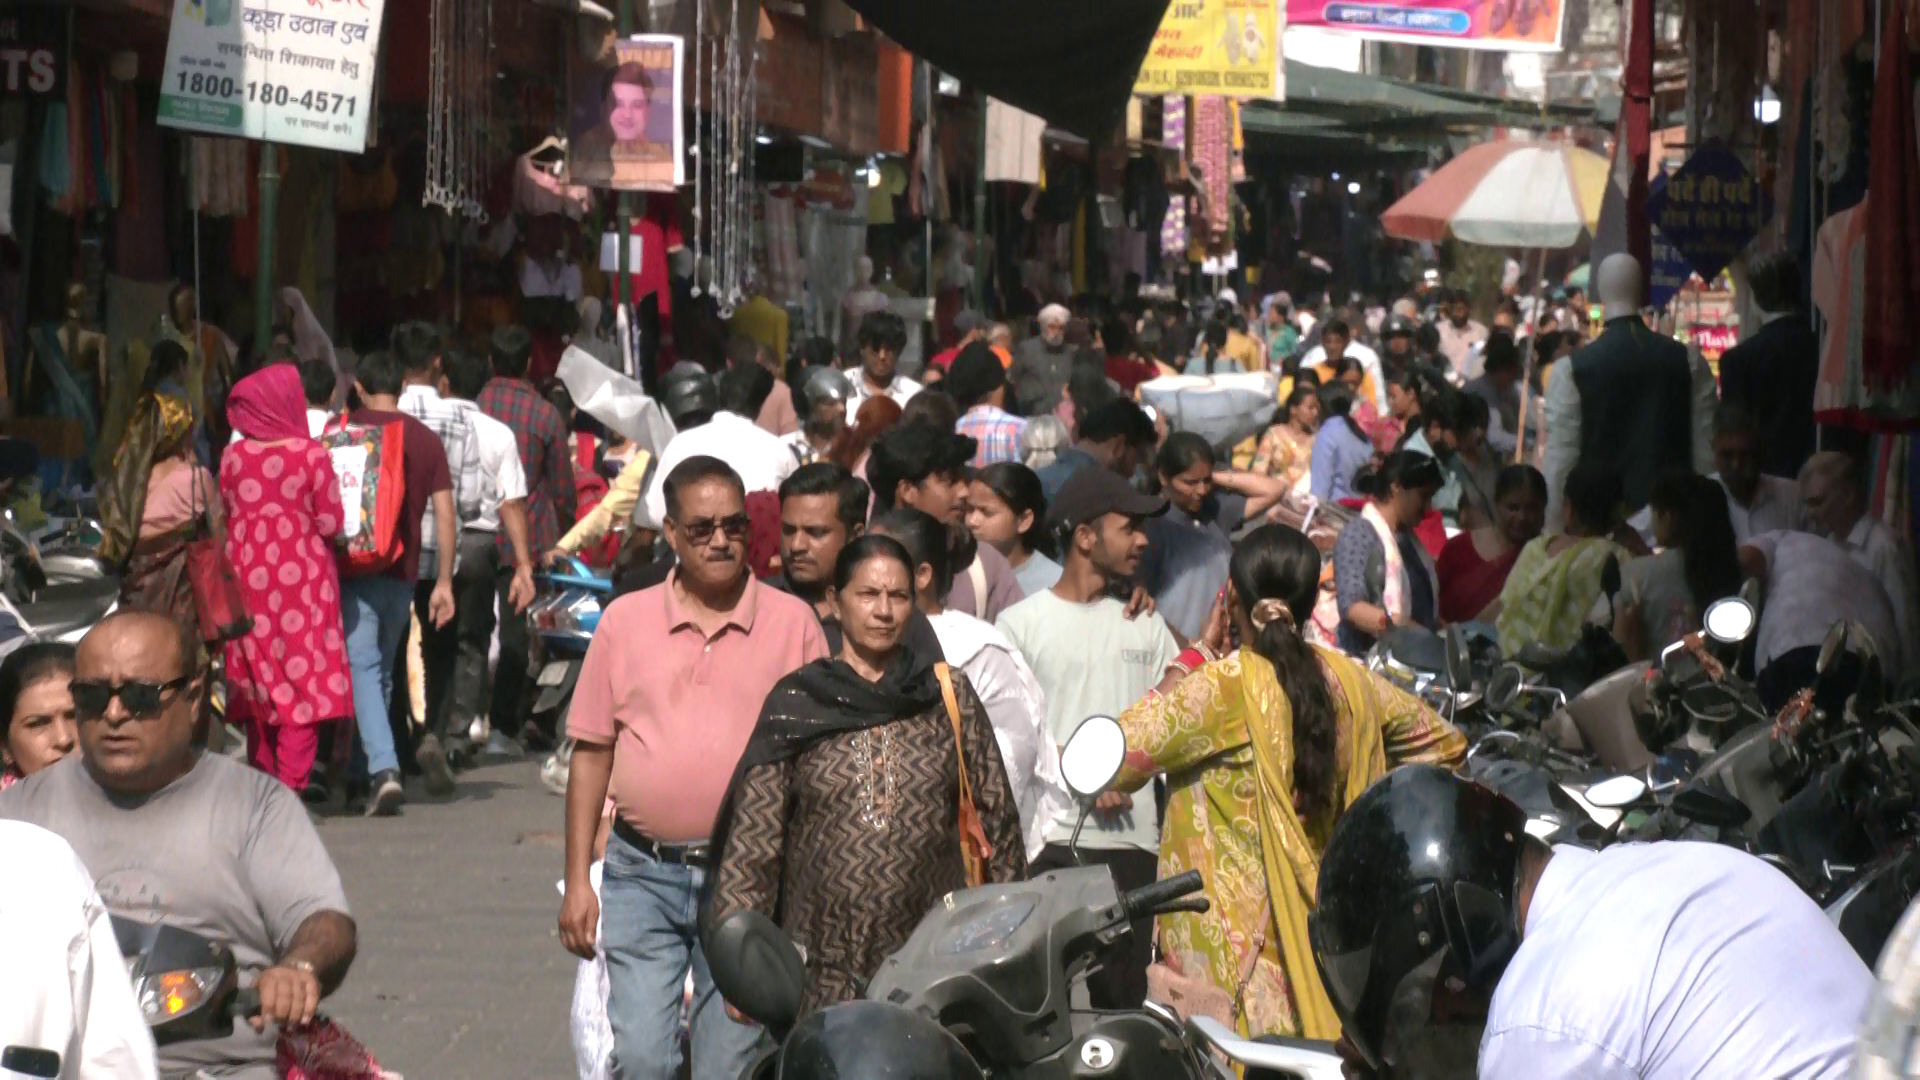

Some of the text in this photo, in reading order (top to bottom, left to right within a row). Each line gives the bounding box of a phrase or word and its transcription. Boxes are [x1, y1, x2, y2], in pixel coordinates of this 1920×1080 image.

[289, 15, 337, 39] उठान
[341, 18, 370, 45] एवं
[177, 70, 357, 117] 1800-180-4571
